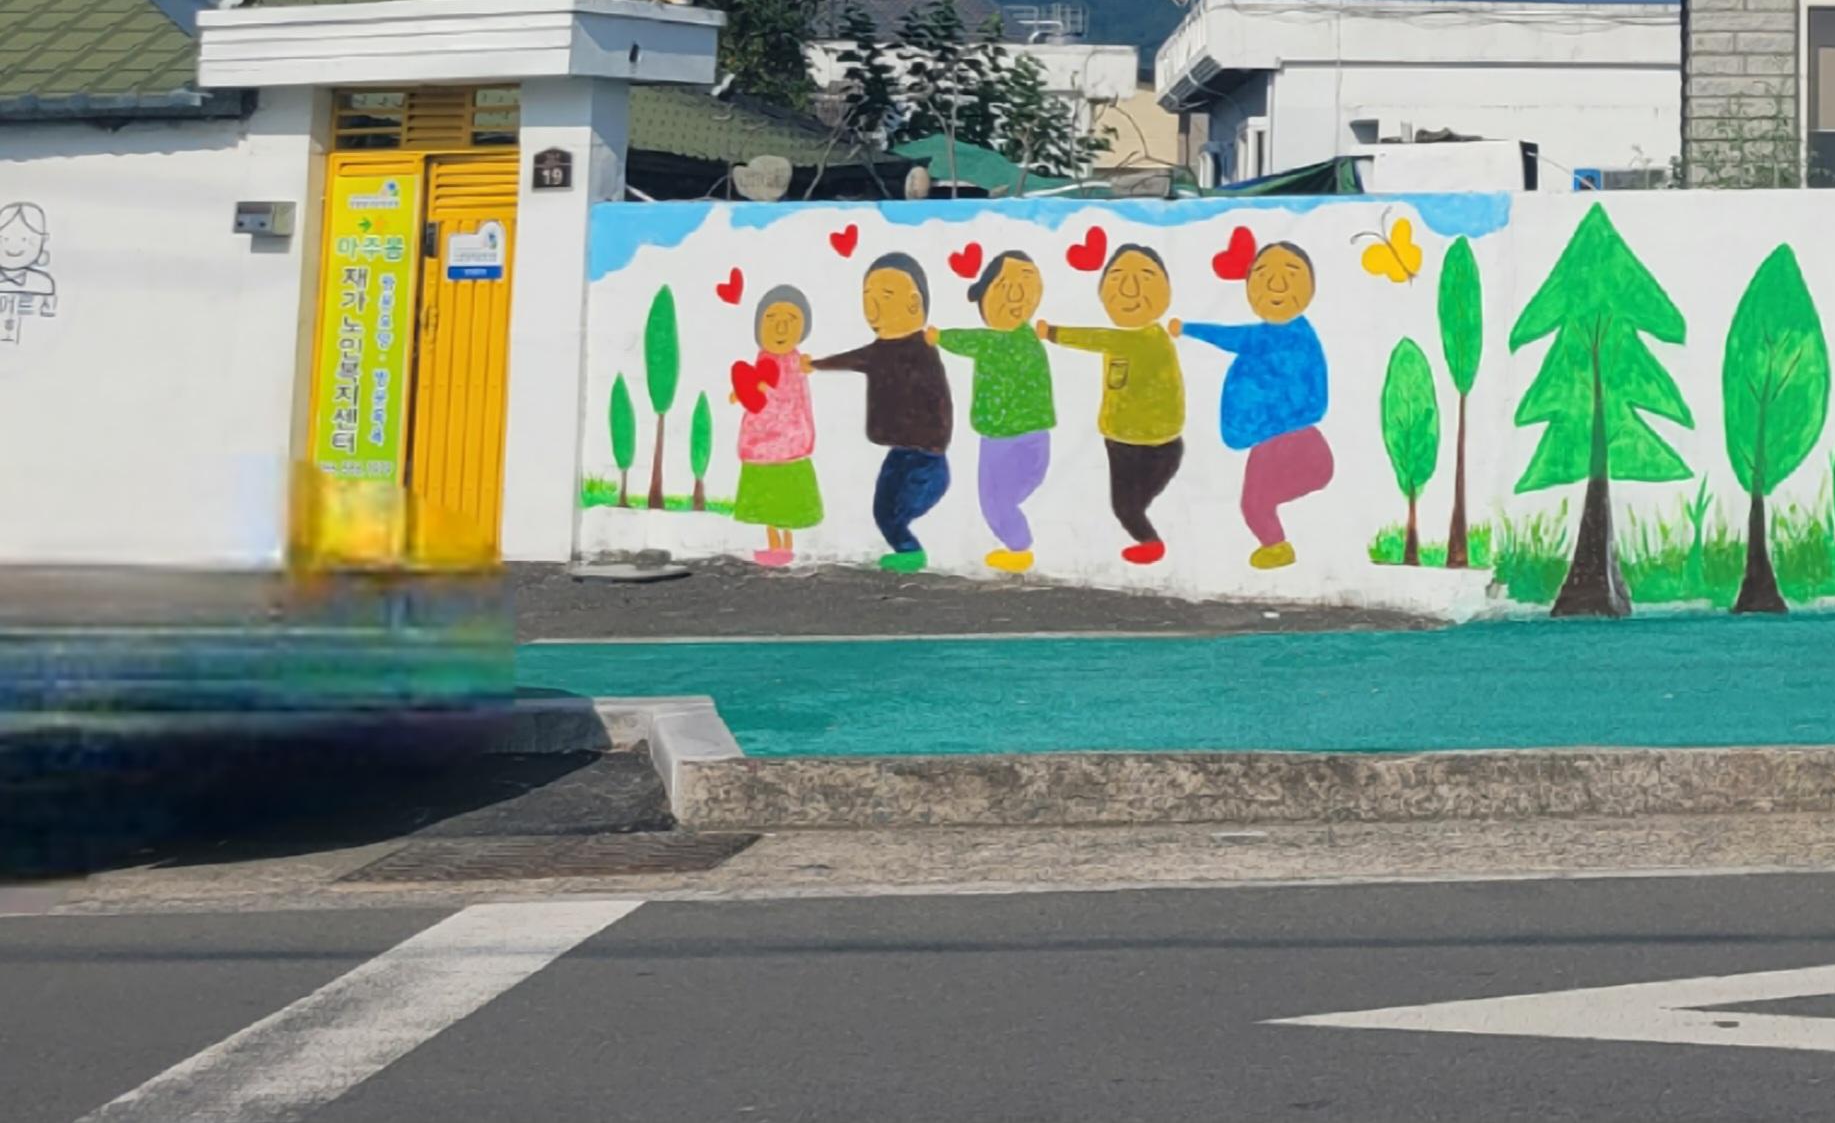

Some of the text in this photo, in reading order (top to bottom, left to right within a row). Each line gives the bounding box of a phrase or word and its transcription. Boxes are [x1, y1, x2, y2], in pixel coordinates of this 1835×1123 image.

[541, 168, 563, 185] 19
[337, 236, 404, 261] 마주봄
[331, 267, 367, 454] 재가노인복지센터
